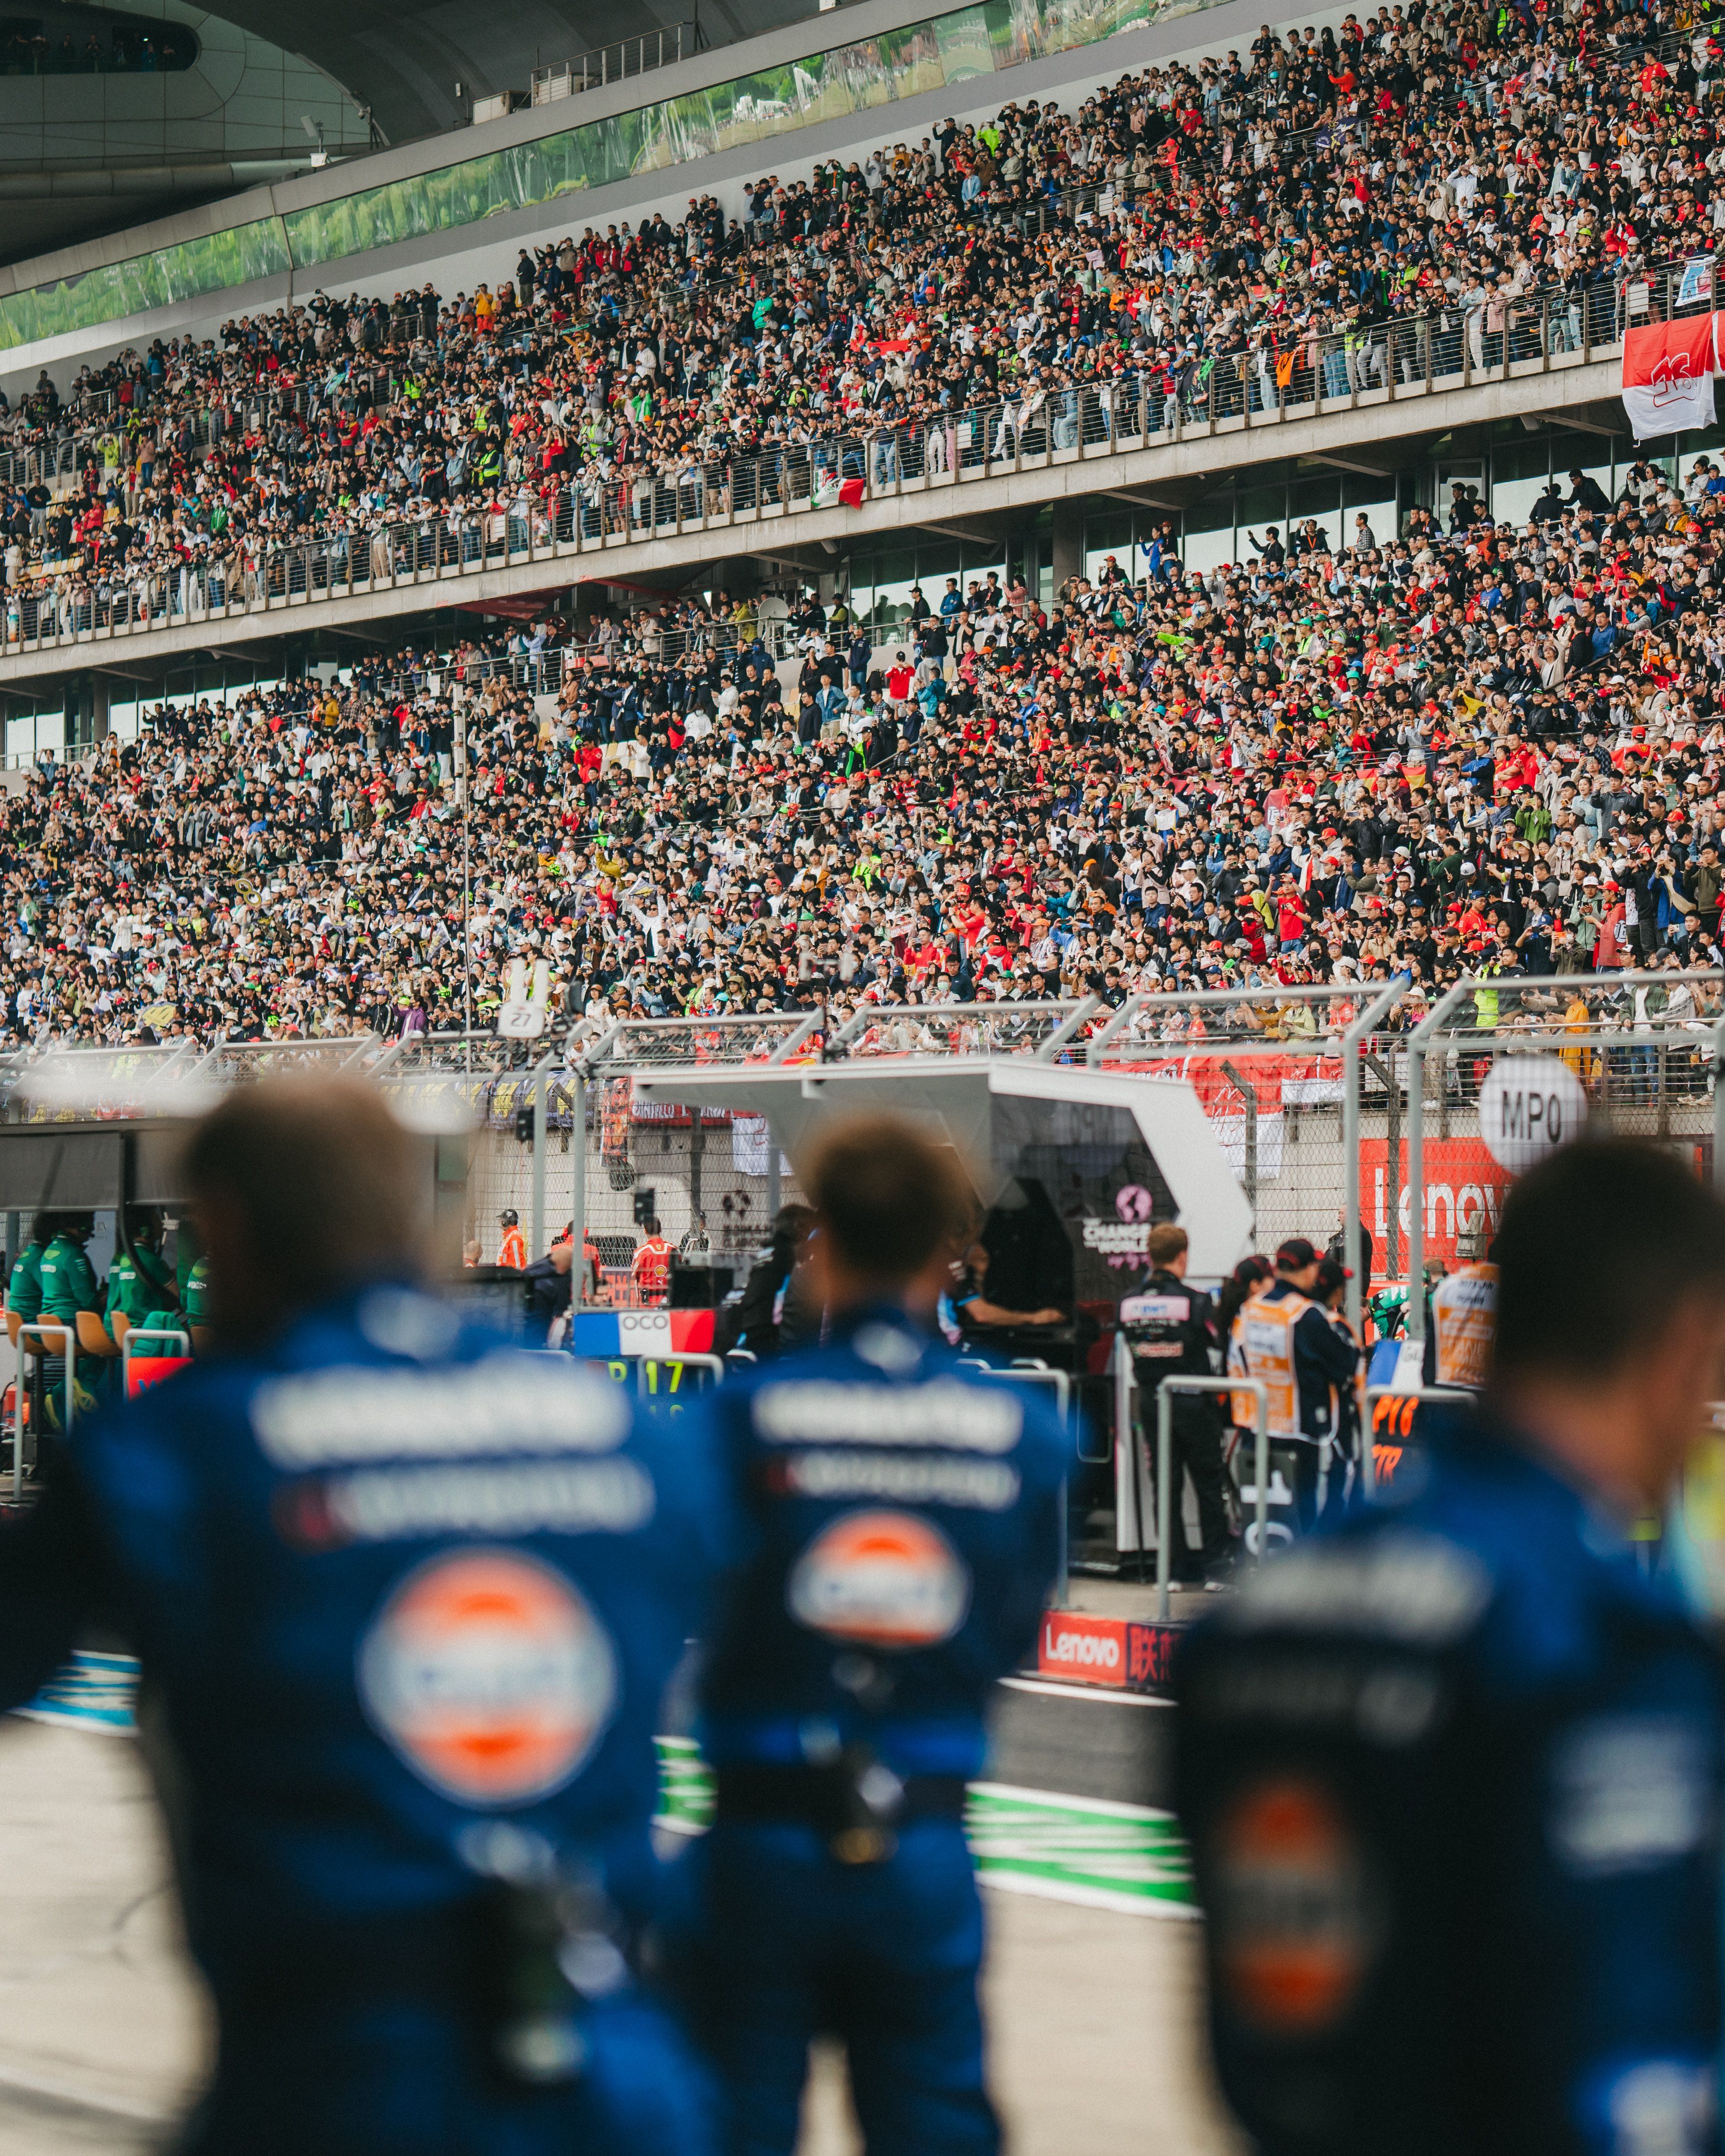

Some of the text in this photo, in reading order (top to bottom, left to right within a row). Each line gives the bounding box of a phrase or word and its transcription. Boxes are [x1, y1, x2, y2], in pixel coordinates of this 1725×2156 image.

[1651, 352, 1697, 408] 16
[511, 1013, 531, 1026] 27
[1375, 1168, 1513, 1239] Lenov
[623, 1315, 668, 1330] OCO
[645, 1360, 684, 1394] 17
[1046, 1623, 1120, 1668] Lenovo
